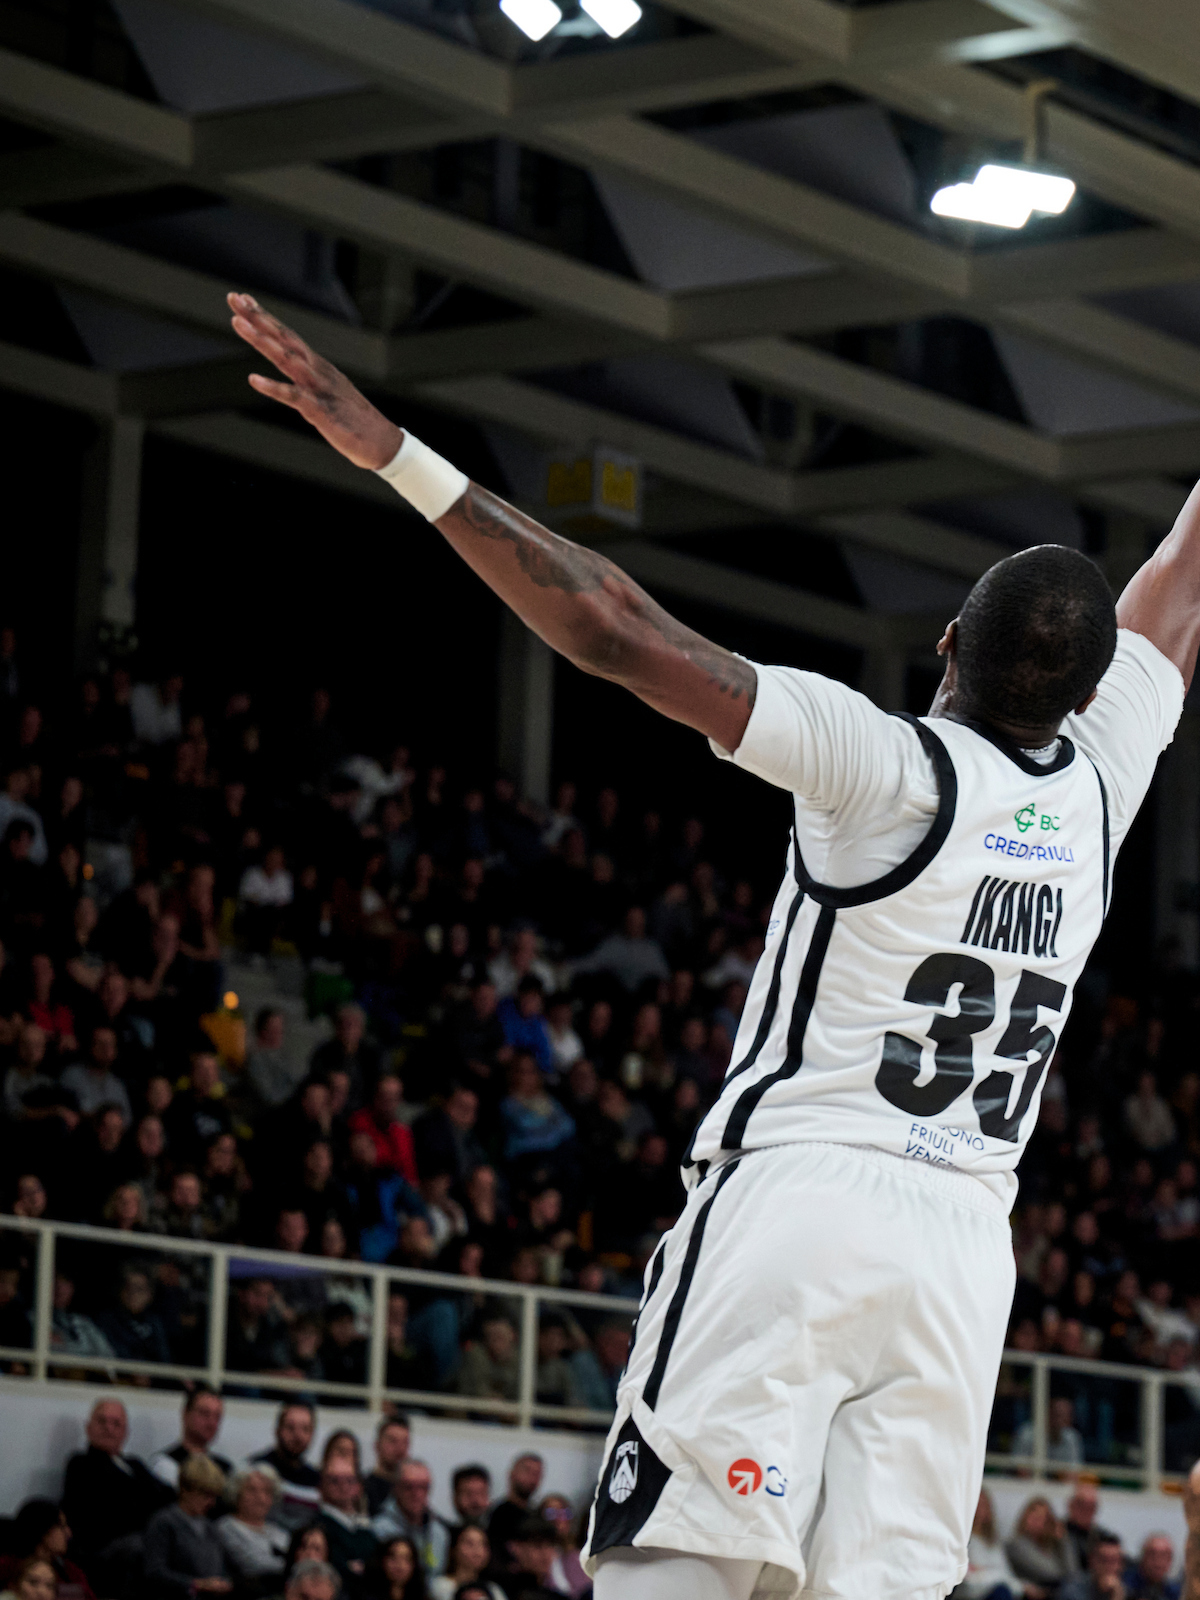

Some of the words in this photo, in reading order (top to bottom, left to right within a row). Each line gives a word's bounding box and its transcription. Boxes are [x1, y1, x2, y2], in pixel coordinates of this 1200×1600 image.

[960, 875, 1063, 958] IKANGI
[875, 952, 1067, 1143] 35
[910, 1123, 955, 1156] FRIULI
